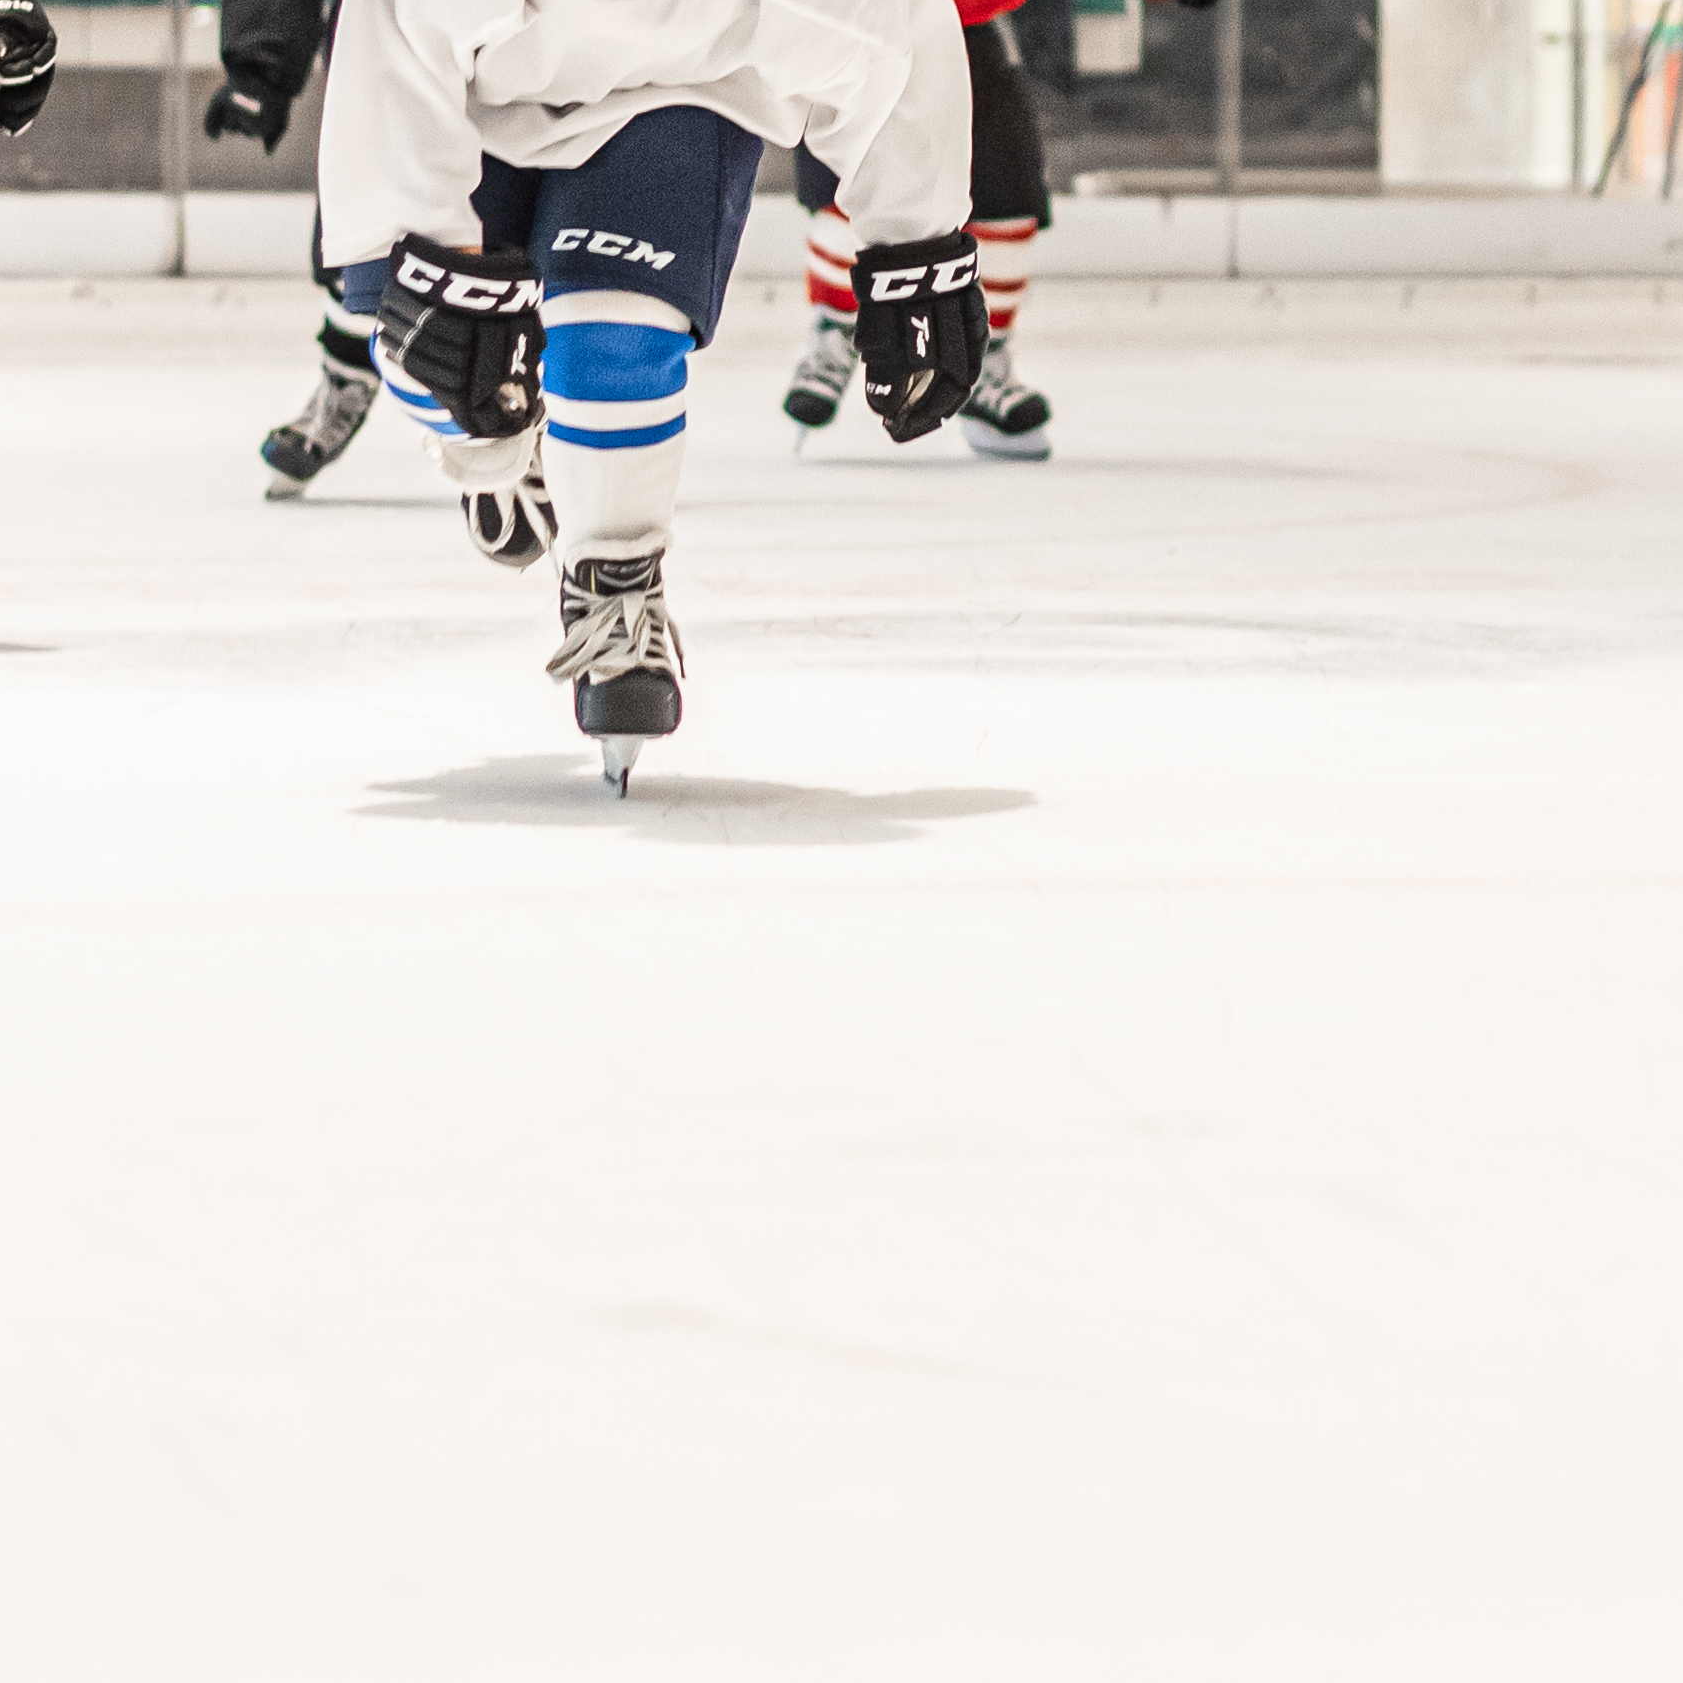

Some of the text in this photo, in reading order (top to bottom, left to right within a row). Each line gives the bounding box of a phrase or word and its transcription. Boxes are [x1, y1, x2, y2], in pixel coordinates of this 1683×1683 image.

[551, 228, 677, 271] CCM
[396, 250, 544, 313] CCM
[870, 251, 980, 302] CC
